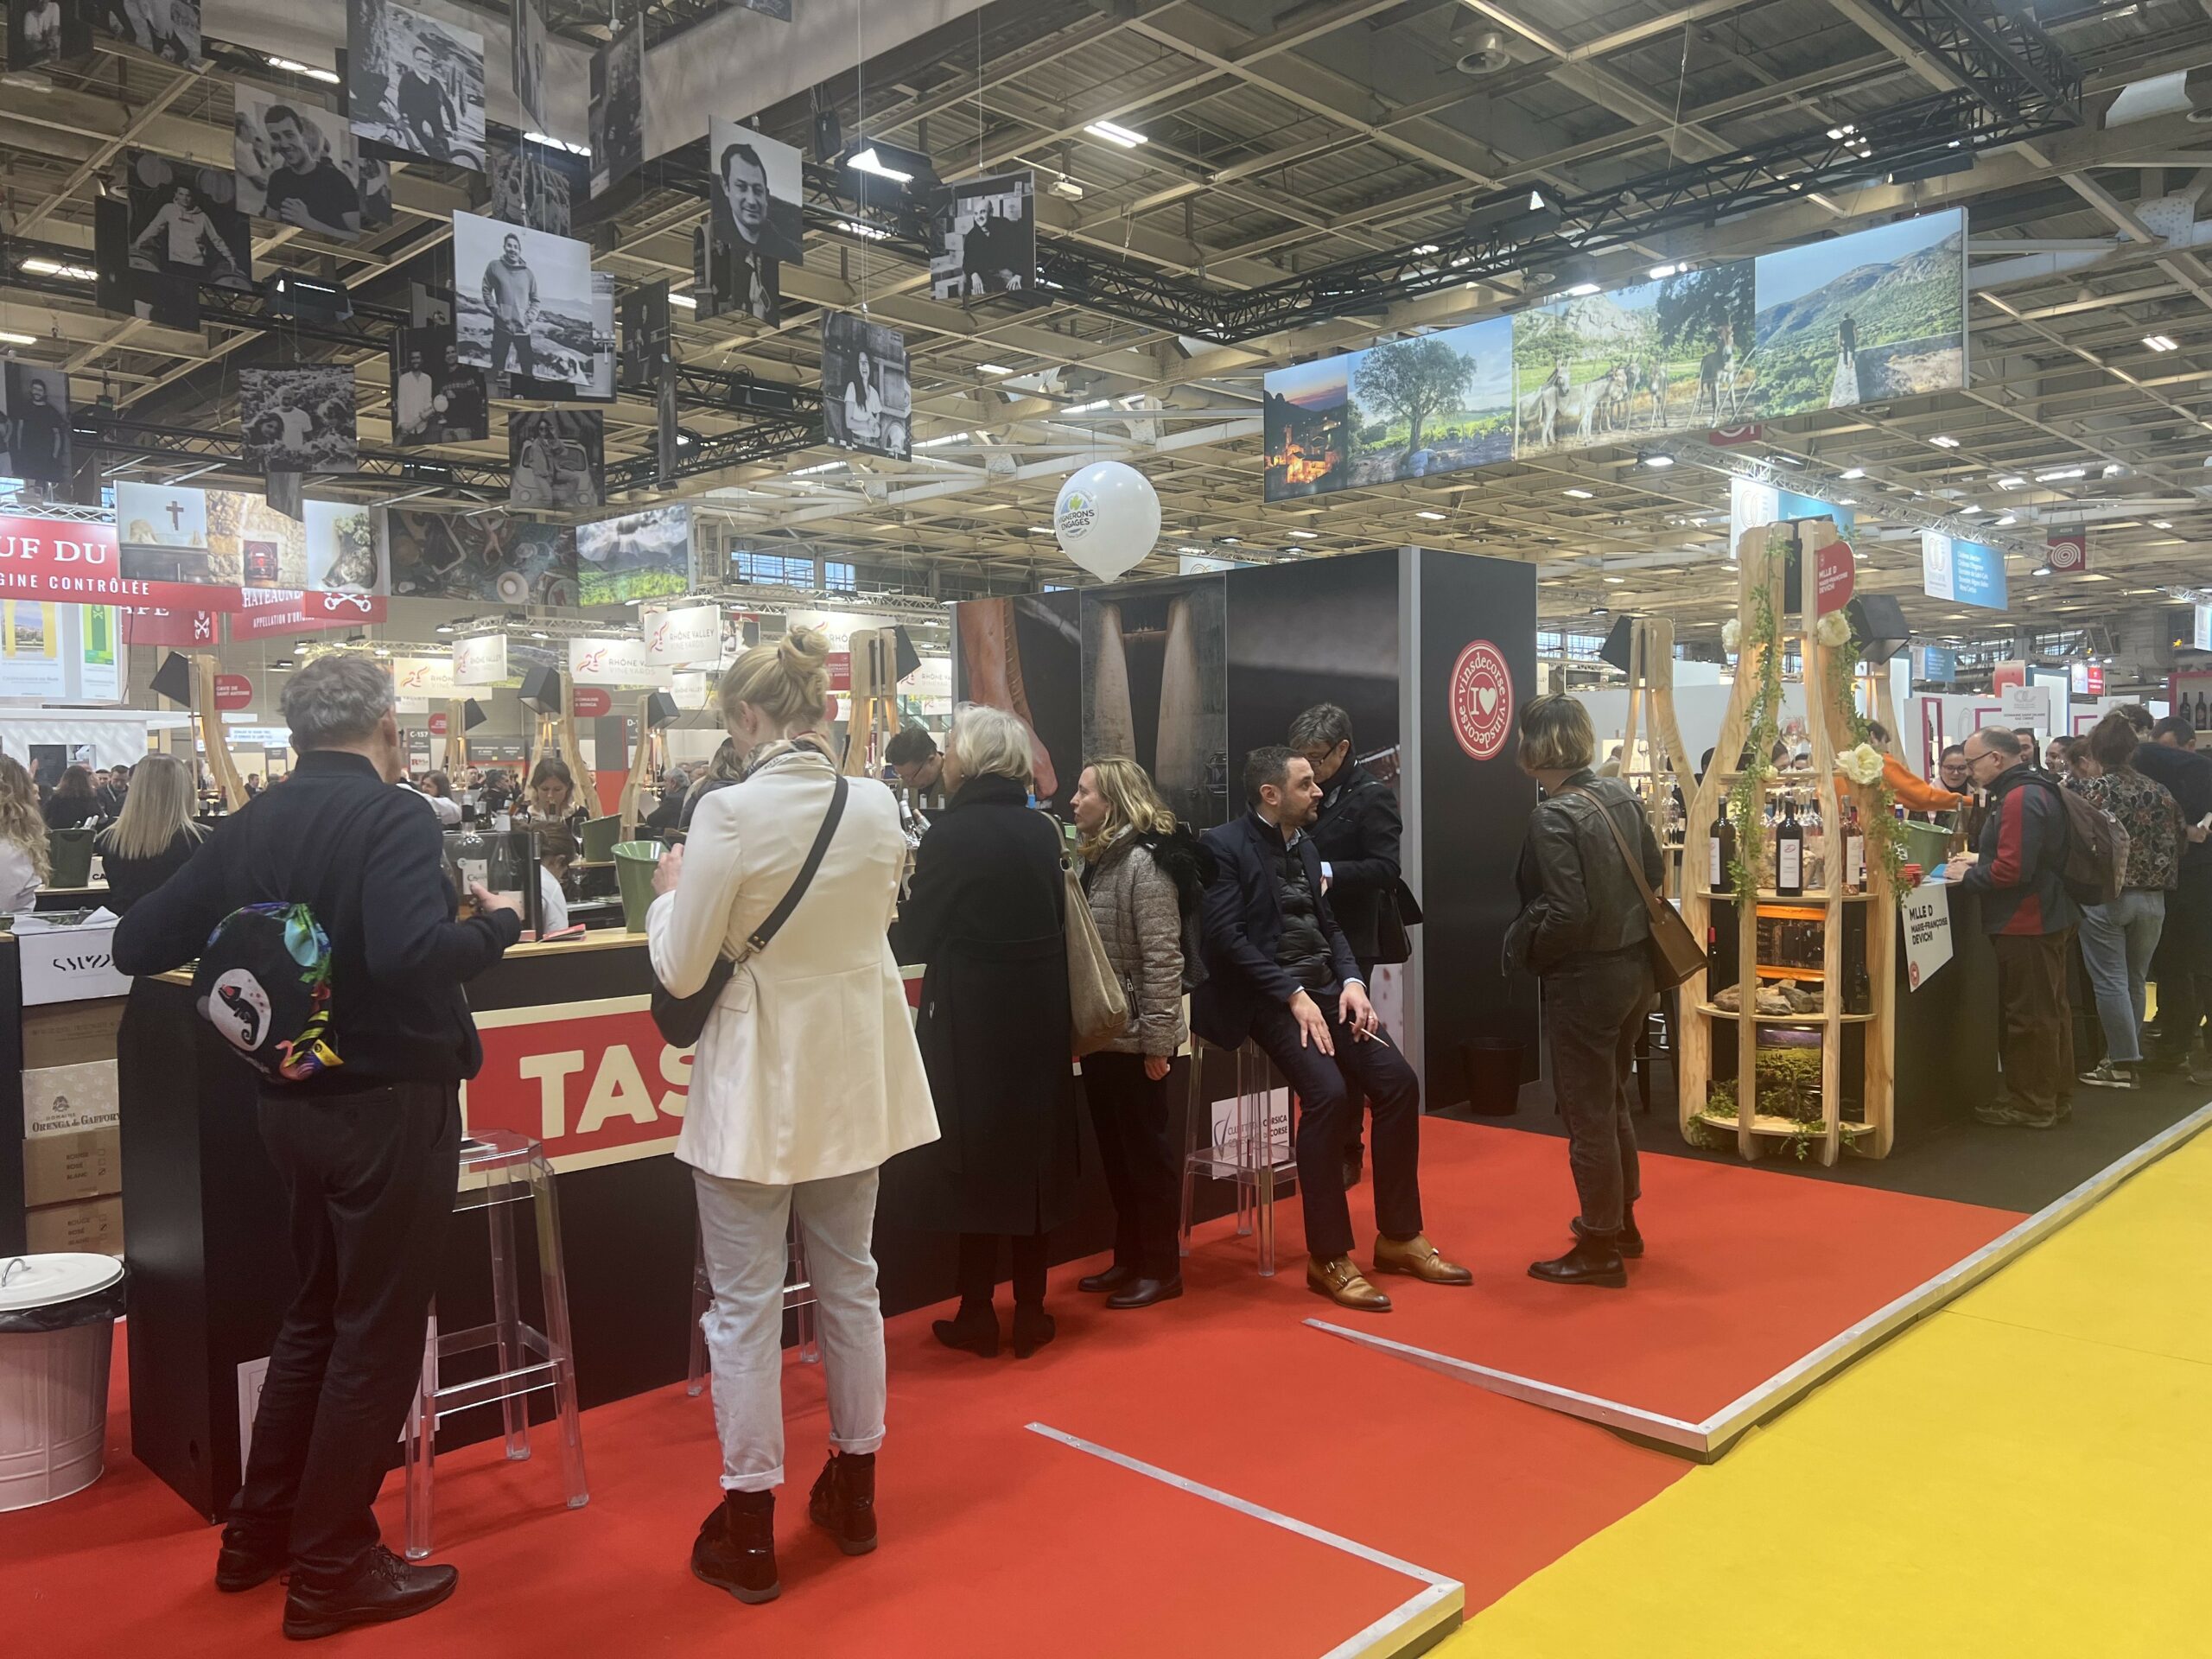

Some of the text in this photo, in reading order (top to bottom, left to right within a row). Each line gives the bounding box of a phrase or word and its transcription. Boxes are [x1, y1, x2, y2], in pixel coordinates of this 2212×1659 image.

[54, 540, 107, 564] DU
[48, 575, 149, 595] CONTRÔLÉE
[253, 613, 286, 628] APPELLATION
[692, 628, 715, 639] VALLEY
[430, 673, 454, 683] RHÔN
[1470, 687, 1480, 715] I
[1909, 904, 1933, 921] MLLE D
[1912, 931, 1934, 945] DEVICHI
[1262, 1114, 1287, 1128] CRSICA
